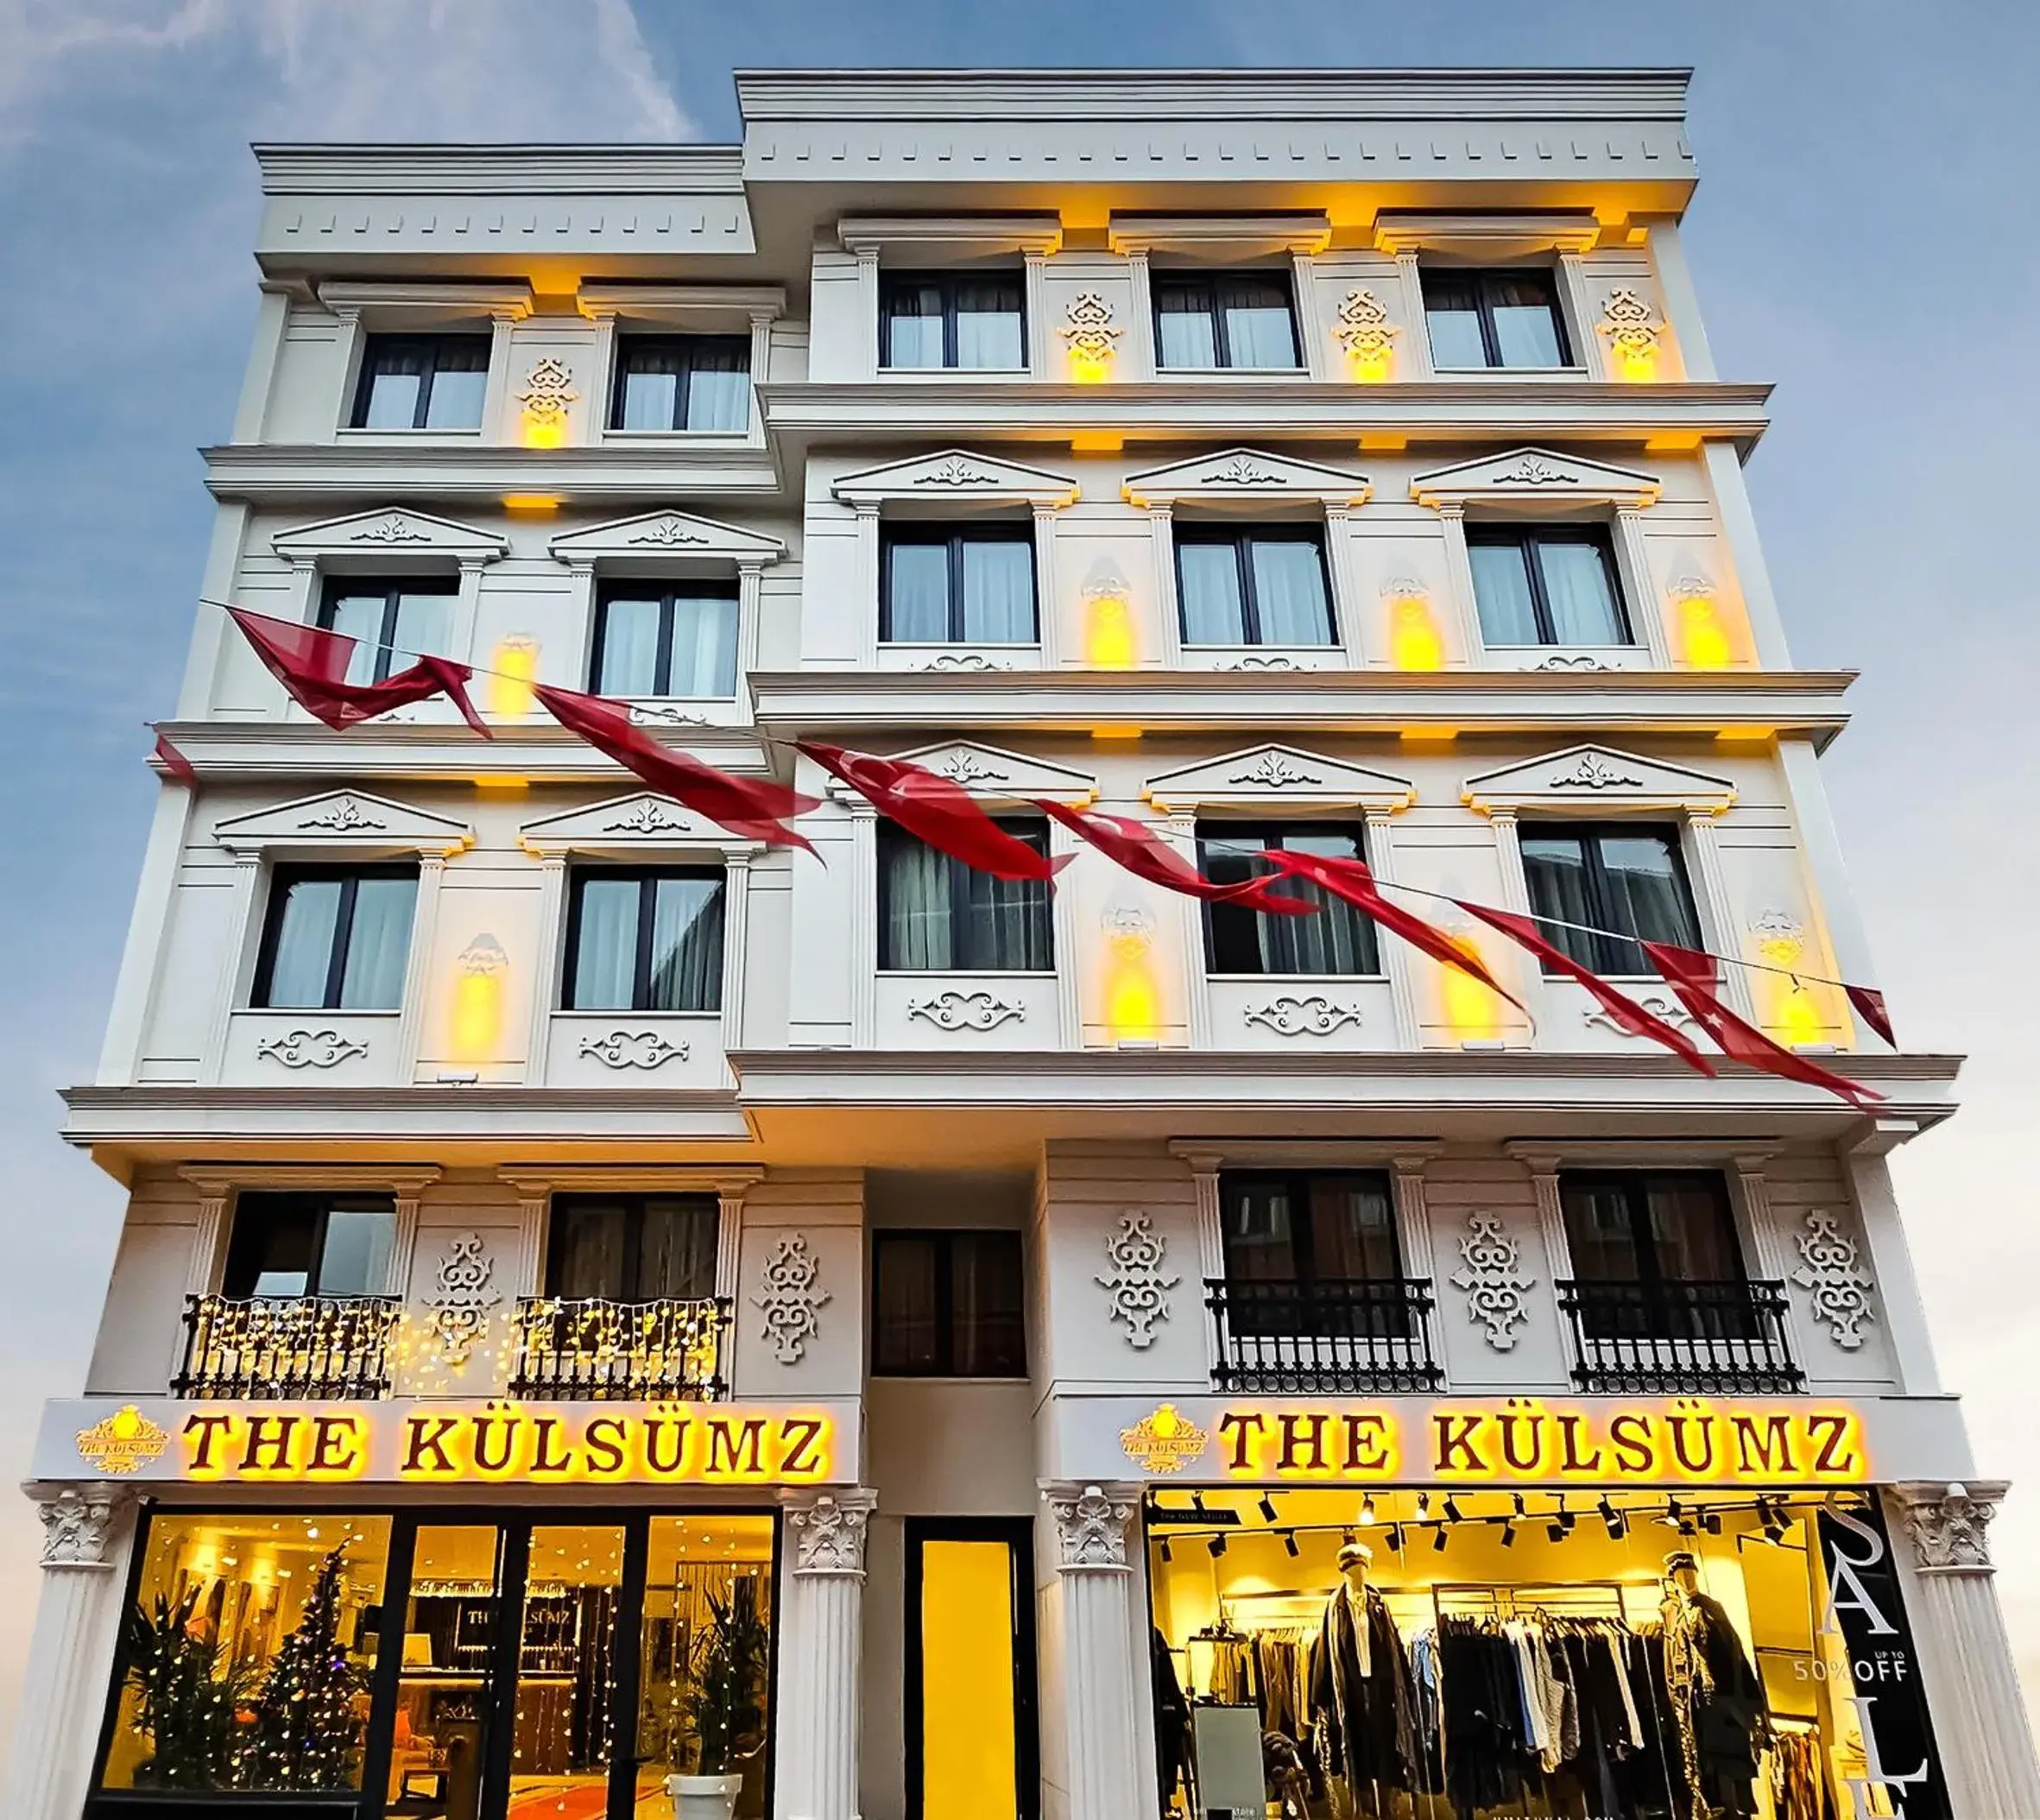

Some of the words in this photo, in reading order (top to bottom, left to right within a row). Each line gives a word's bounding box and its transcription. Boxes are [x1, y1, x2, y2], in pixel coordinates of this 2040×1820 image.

[183, 1413, 356, 1470] THE
[401, 1400, 822, 1473] KÜLSÜMZ
[1219, 1412, 1388, 1470] THE
[1433, 1398, 1854, 1472] KÜLSÜMZ
[1854, 1660, 1907, 1682] OFF
[1874, 1651, 1889, 1659] UP
[1892, 1651, 1904, 1659] TO
